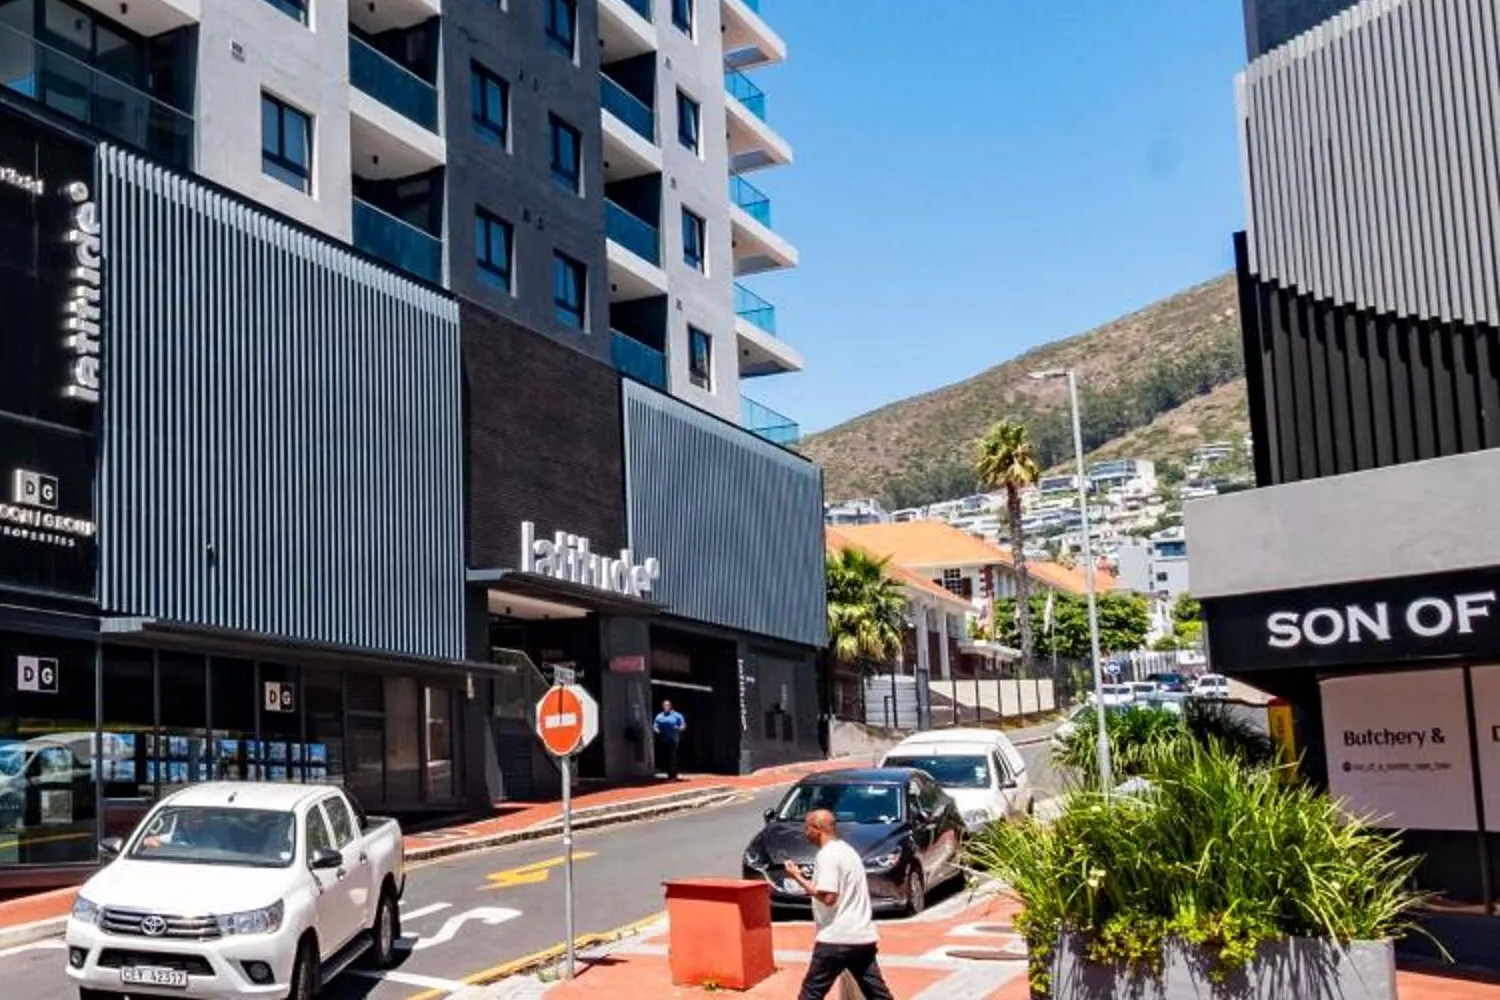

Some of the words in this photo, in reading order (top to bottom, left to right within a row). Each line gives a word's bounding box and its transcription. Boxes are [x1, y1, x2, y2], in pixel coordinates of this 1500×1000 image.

[1266, 602, 1391, 648] SON
[1405, 591, 1497, 638] OF
[1343, 727, 1425, 748] Butchery
[1431, 727, 1445, 743] &
